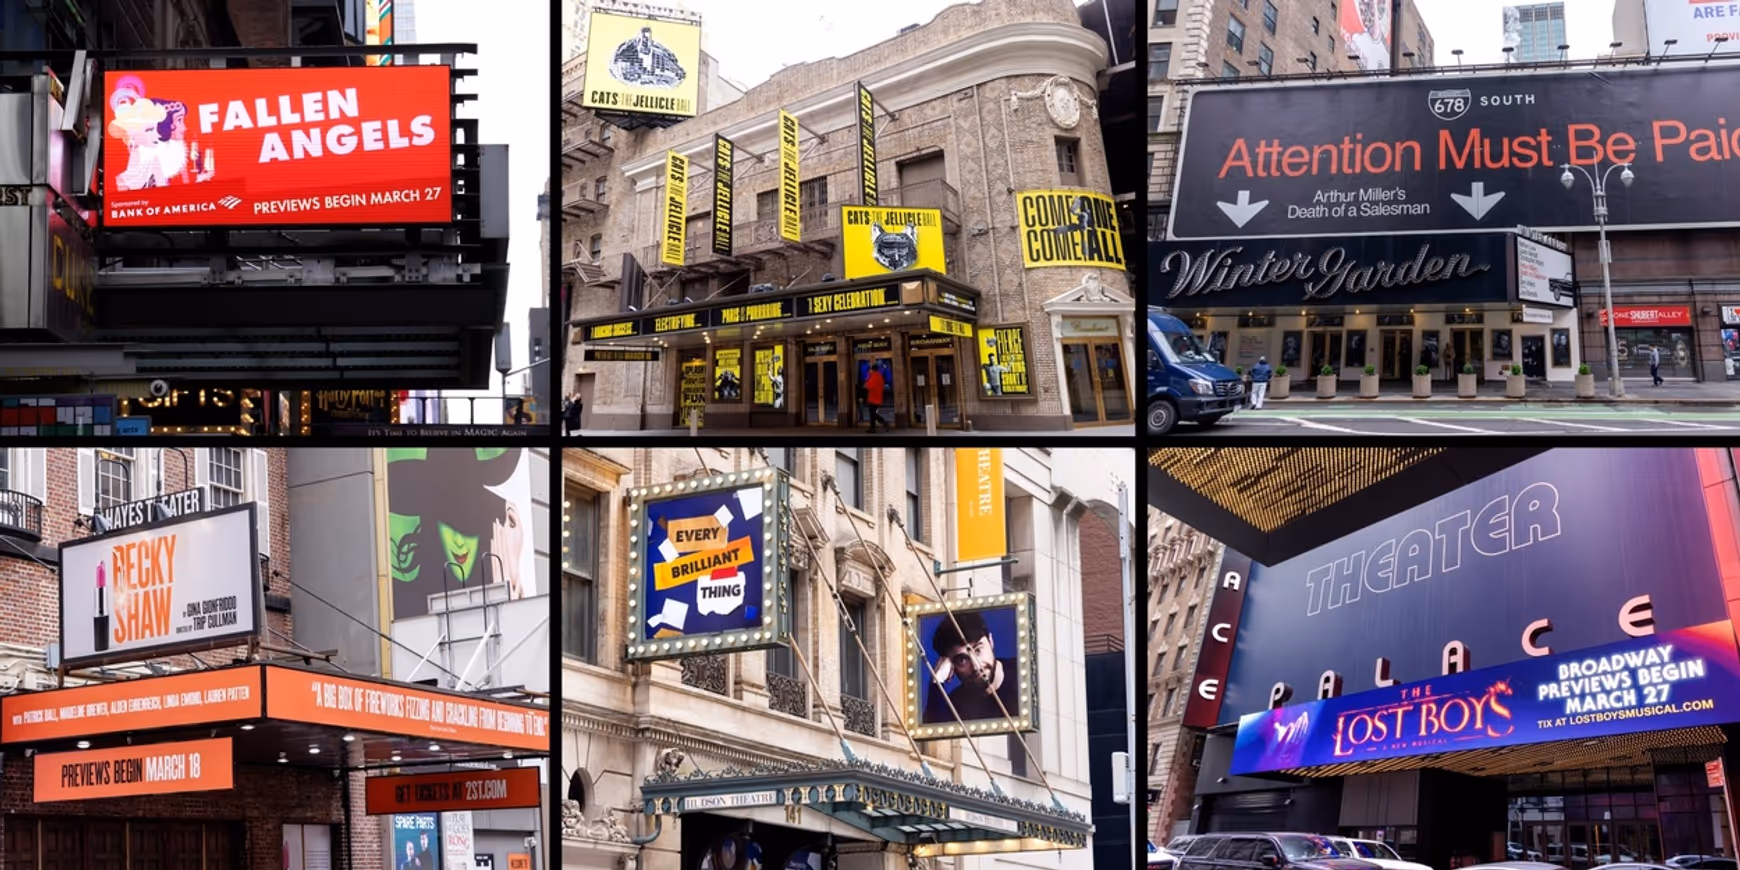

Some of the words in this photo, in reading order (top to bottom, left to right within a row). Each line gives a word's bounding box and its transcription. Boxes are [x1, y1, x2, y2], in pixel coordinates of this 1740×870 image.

[1694, 6, 1725, 19] ARE
[1729, 4, 1740, 17] F
[198, 88, 359, 134] FALLEN
[591, 91, 619, 106] CATS
[633, 95, 675, 111] JELLICLE
[860, 87, 873, 125] CATS
[1434, 98, 1465, 113] 678
[1480, 94, 1536, 107] SOUTH
[258, 115, 435, 163] ANGELS
[783, 114, 797, 148] CATS
[717, 138, 732, 169] CATS
[1217, 132, 1422, 179] Attention
[1438, 127, 1554, 171] Must
[1568, 123, 1636, 166] Be
[670, 155, 685, 183] CATS
[863, 139, 877, 202] JELLICLE
[0, 186, 30, 206] ST
[254, 197, 321, 215] PREVIEWS
[325, 194, 367, 209] BEGIN
[370, 189, 421, 205] MARCH
[424, 186, 442, 201] 27
[784, 161, 797, 215] JELLICLE
[1313, 189, 1356, 203] Arthur
[1359, 187, 1407, 201] Miller's
[111, 206, 143, 219] BANK
[146, 205, 160, 216] OF
[163, 202, 216, 215] AMERICA
[667, 196, 683, 243] JELLICLE
[717, 181, 731, 233] JELLICLE
[847, 210, 870, 225] CATS
[884, 211, 922, 226] JELLICLE
[1022, 194, 1081, 228] COME
[1079, 195, 1117, 232] ONE
[1288, 204, 1329, 219] Death
[1331, 204, 1346, 218] of
[1348, 206, 1357, 217] a
[1360, 202, 1431, 217] Salesman
[1026, 228, 1083, 262] COME
[1085, 228, 1123, 265] ALL
[1160, 246, 1315, 299] Winter
[1302, 243, 1491, 300] Garden
[814, 294, 833, 314] SEXY
[1630, 309, 1658, 320] SHUBERT
[1658, 311, 1684, 319] ALLEY
[464, 428, 498, 437] MAGIC
[501, 429, 528, 437] AGAIN
[105, 500, 143, 531] HAYES
[145, 490, 199, 523] TEATER
[676, 527, 720, 543] EVERY
[1306, 482, 1561, 616] THEATER
[112, 534, 176, 595] BECKY
[671, 548, 741, 579] BRILLIANT
[700, 584, 742, 600] THING
[114, 587, 173, 645] SHAW
[187, 601, 201, 617] GINA
[193, 615, 206, 631] TRIP
[1268, 594, 1655, 710] PALACE
[1557, 645, 1673, 681] BROADWAY
[1401, 685, 1432, 699] THE
[1538, 672, 1632, 701] PREVIEWS
[1638, 659, 1705, 681] BEGIN
[324, 683, 337, 708] BIG
[338, 685, 353, 711] BOX
[354, 687, 363, 712] OF
[365, 689, 404, 717] FIREWORKS
[405, 695, 430, 721] FIZZING
[431, 700, 444, 722] AND
[1537, 719, 1553, 729] TIX
[1554, 717, 1567, 727] AT
[1569, 699, 1715, 725] LOSTBOYSMUSICAL.COM
[1565, 690, 1636, 714] MARCH
[1643, 683, 1670, 705] 27
[1332, 704, 1414, 756] LOST
[1419, 680, 1516, 738] BOYS
[1411, 738, 1448, 748] MUSICAL
[61, 760, 110, 788] PREVIEWS
[114, 757, 143, 784] BEGIN
[145, 754, 185, 782] MARCH
[189, 752, 201, 779] 18
[395, 784, 410, 804] GET
[415, 782, 448, 802] TICKETS
[452, 781, 463, 800] AT
[465, 779, 507, 801] 2ST.COM
[686, 796, 726, 809] HUDSON
[730, 793, 775, 805] THEATRE
[394, 815, 415, 830] SPARE
[416, 815, 435, 830] PARTS
[784, 804, 802, 825] 141
